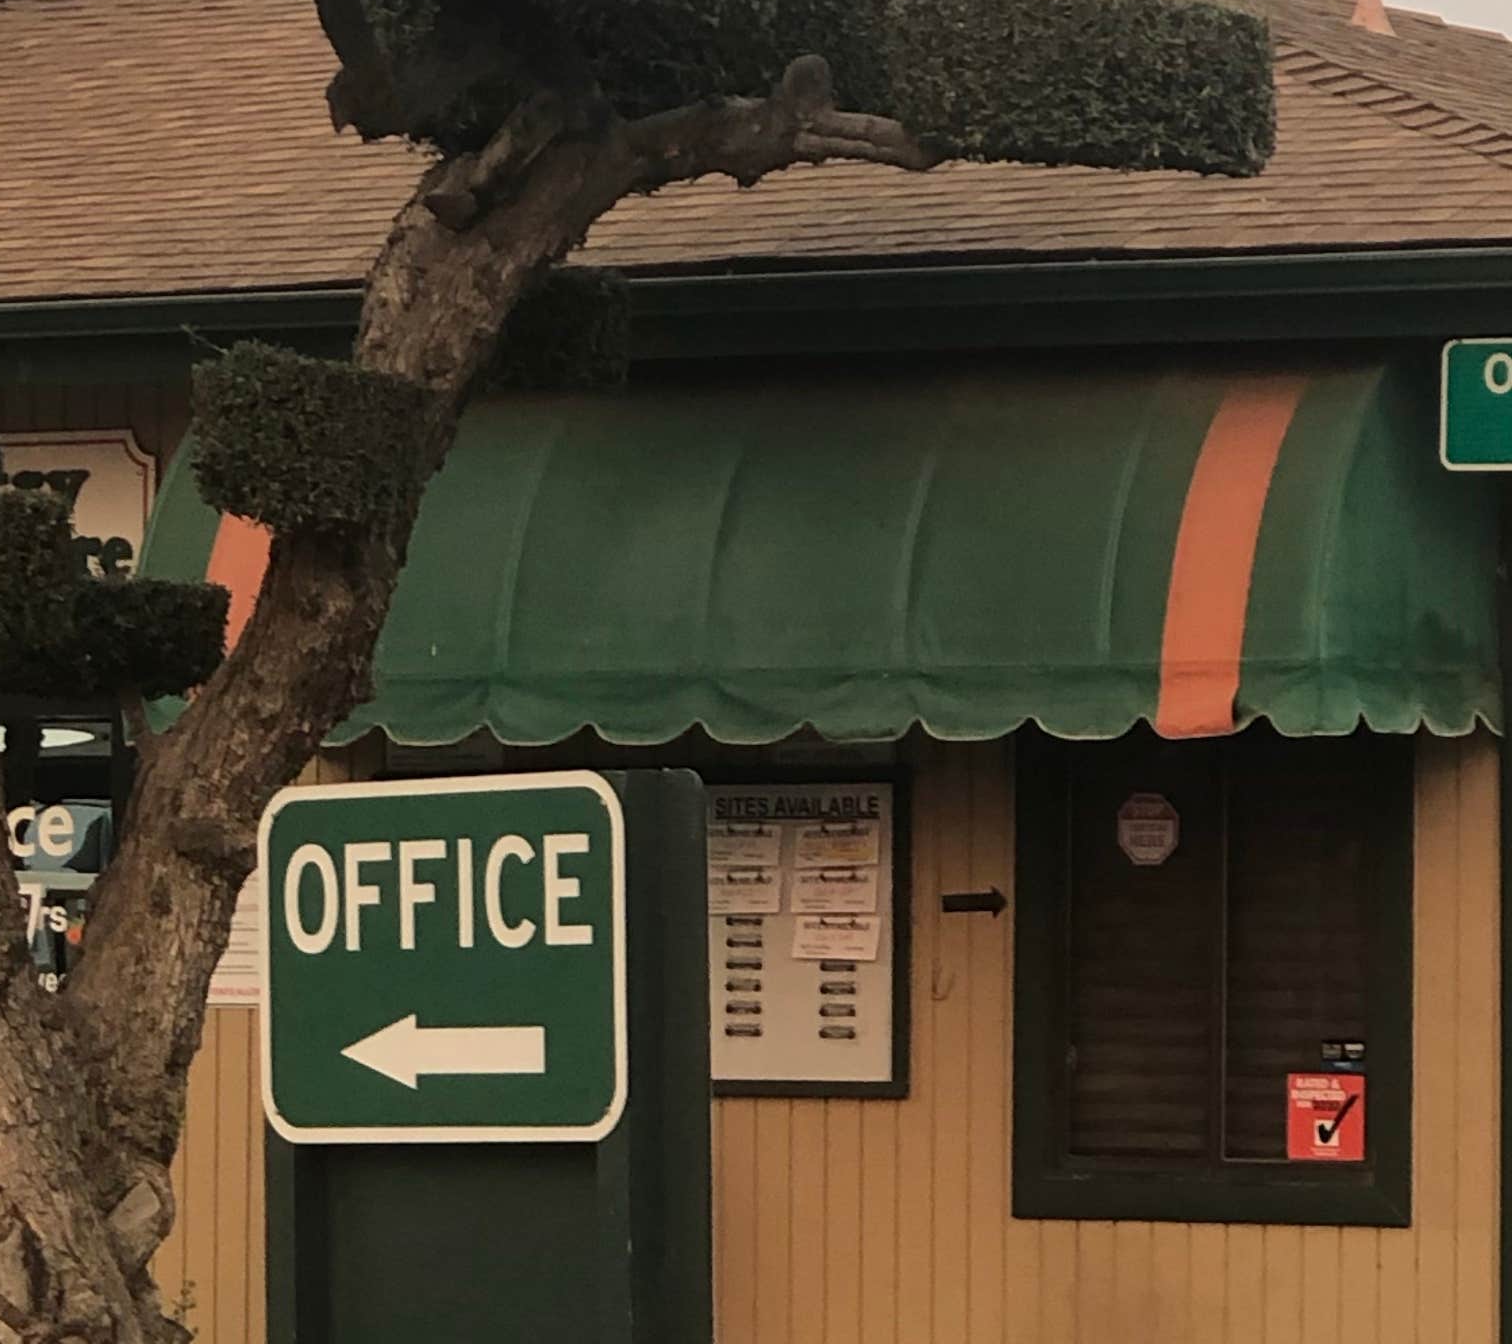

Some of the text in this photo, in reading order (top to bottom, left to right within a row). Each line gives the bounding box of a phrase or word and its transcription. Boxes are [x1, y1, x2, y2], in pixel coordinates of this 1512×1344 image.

[715, 796, 880, 817] SITES AVAILABLE
[284, 833, 593, 954] OFFICE
